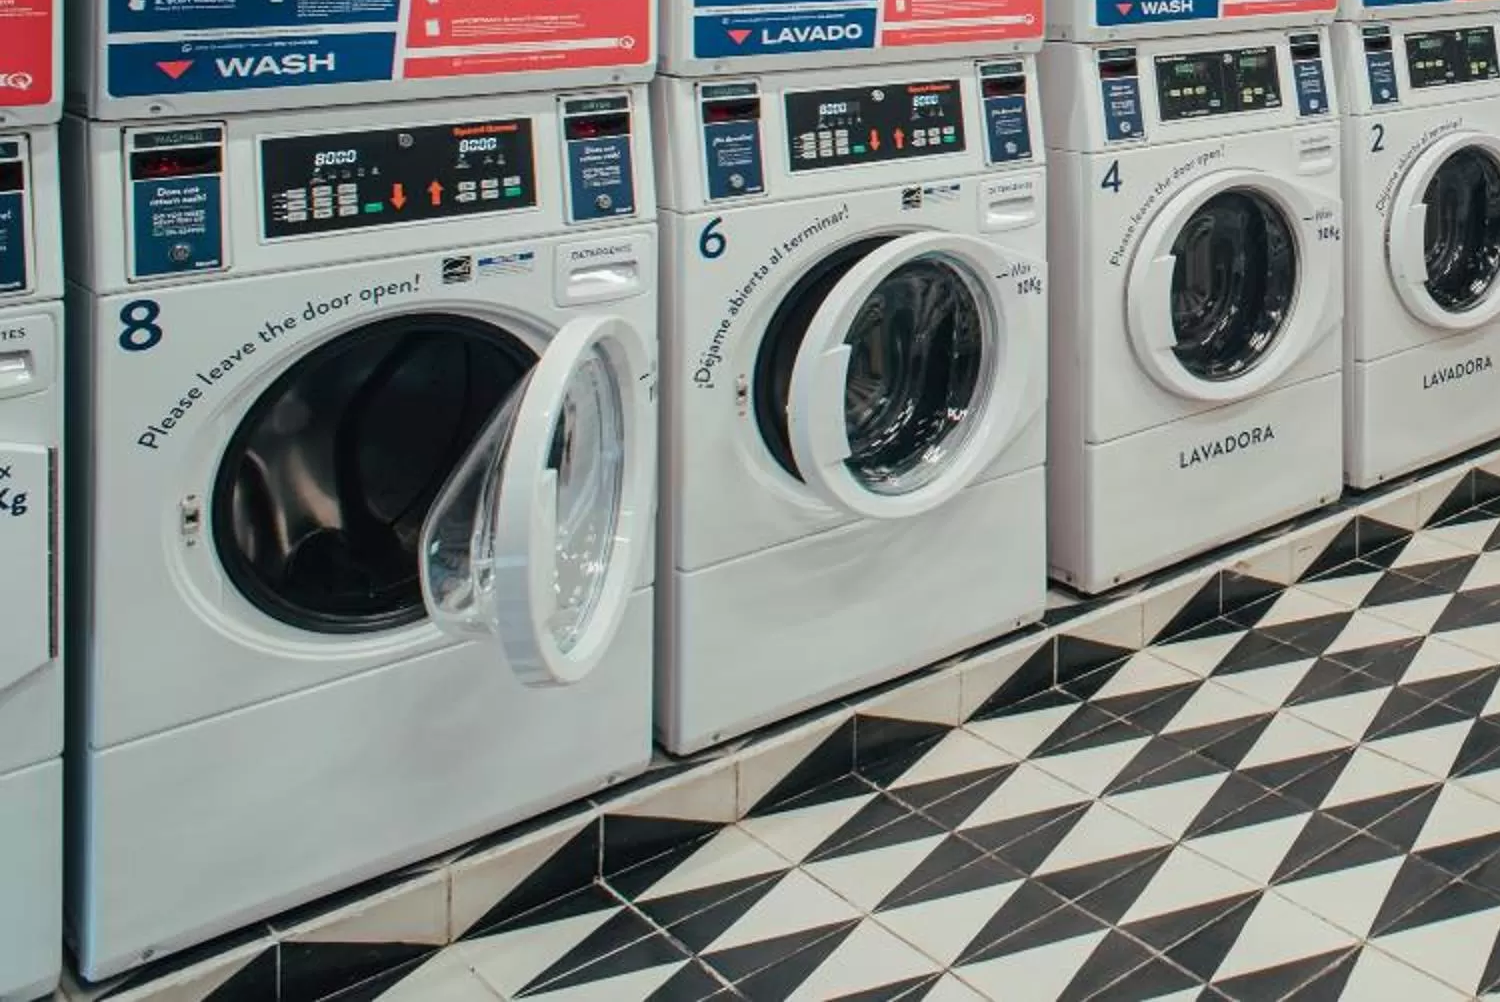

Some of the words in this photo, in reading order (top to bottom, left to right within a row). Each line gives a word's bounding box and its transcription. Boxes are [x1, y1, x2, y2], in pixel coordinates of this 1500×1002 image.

[1141, 0, 1193, 15] WASH
[761, 23, 863, 45] LAVADO
[215, 53, 335, 78] WASH
[1371, 123, 1385, 153] 2
[1100, 159, 1123, 193] 4
[699, 216, 727, 259] 6
[727, 263, 769, 317] abierta
[769, 246, 784, 266] al
[783, 202, 850, 254] terminar!
[118, 298, 163, 351] 8
[137, 384, 204, 450] Please
[196, 341, 257, 387] leave
[257, 316, 298, 344] the
[302, 292, 353, 322] door
[358, 272, 422, 306] open!
[1423, 355, 1493, 390] LAVADORA
[1178, 424, 1276, 469] LAVADORA
